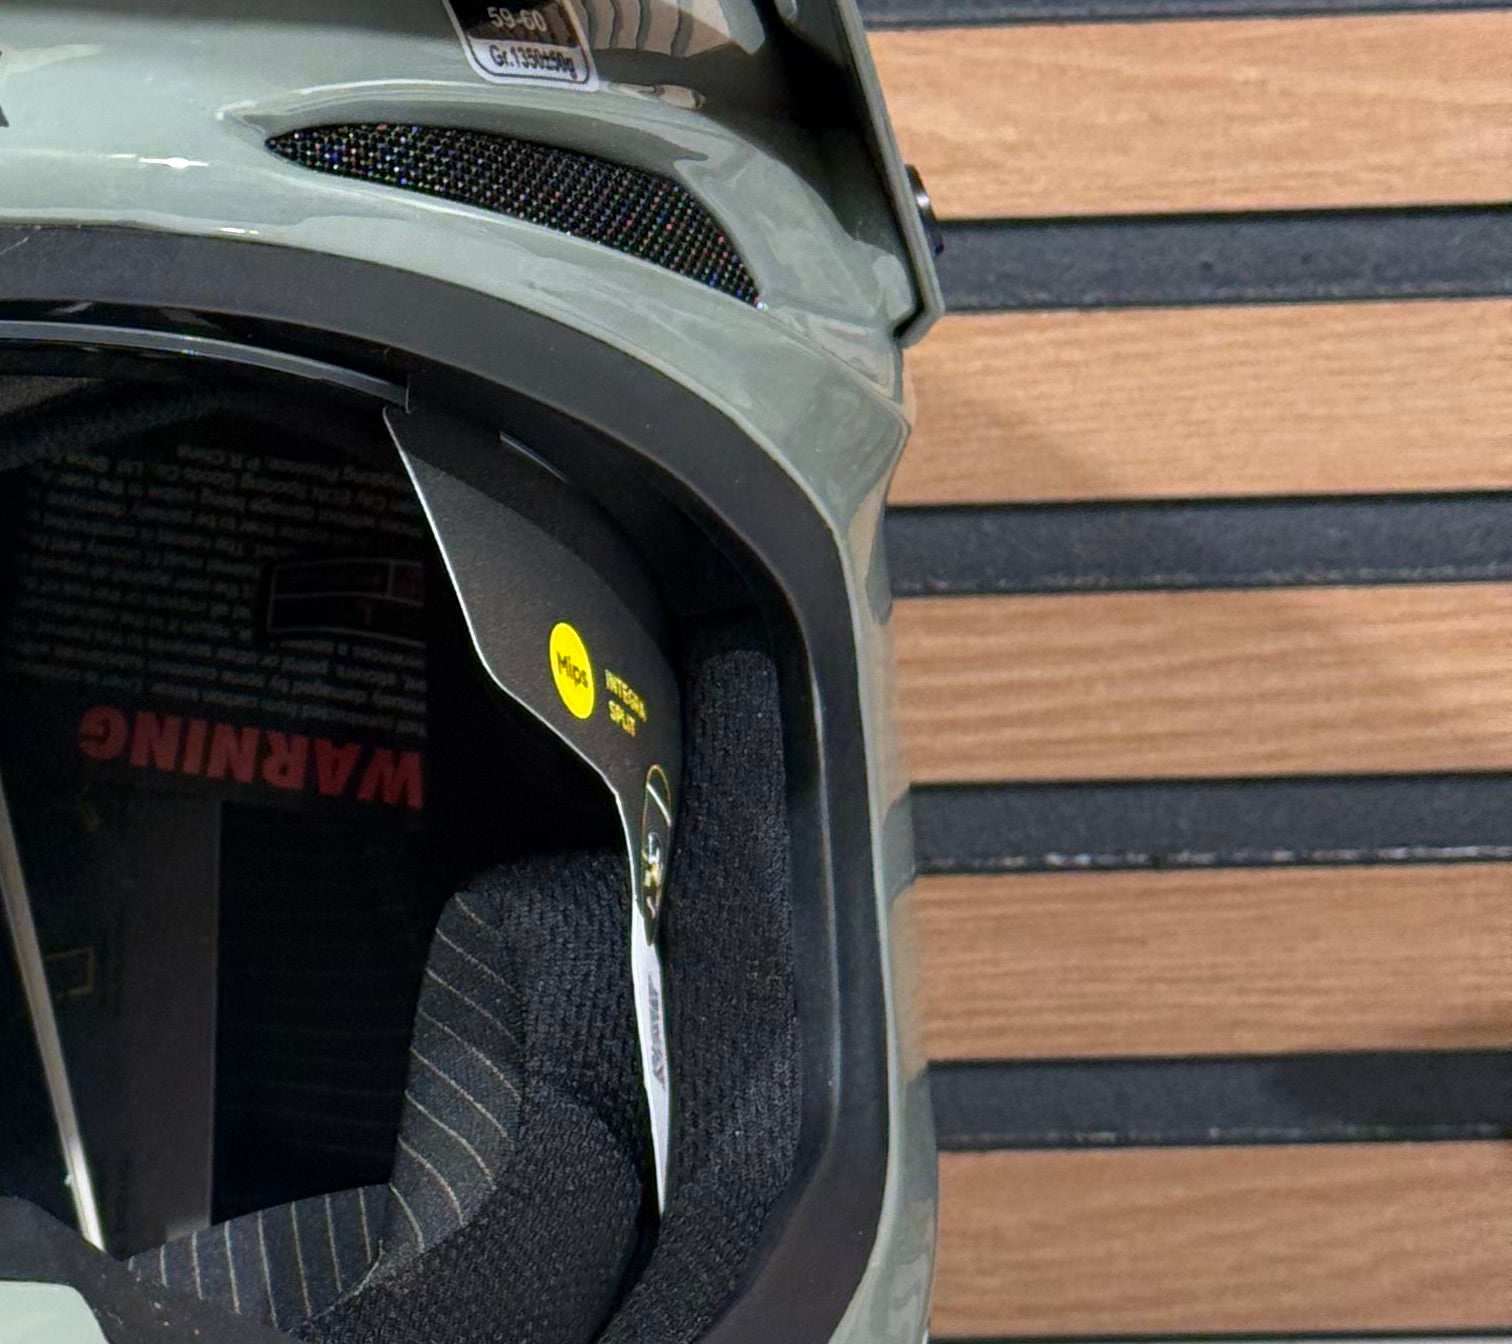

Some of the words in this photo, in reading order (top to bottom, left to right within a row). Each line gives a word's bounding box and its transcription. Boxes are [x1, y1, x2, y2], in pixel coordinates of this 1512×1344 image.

[488, 6, 548, 32] 59-60
[557, 651, 588, 689] Mips
[78, 705, 424, 809] WARNING
